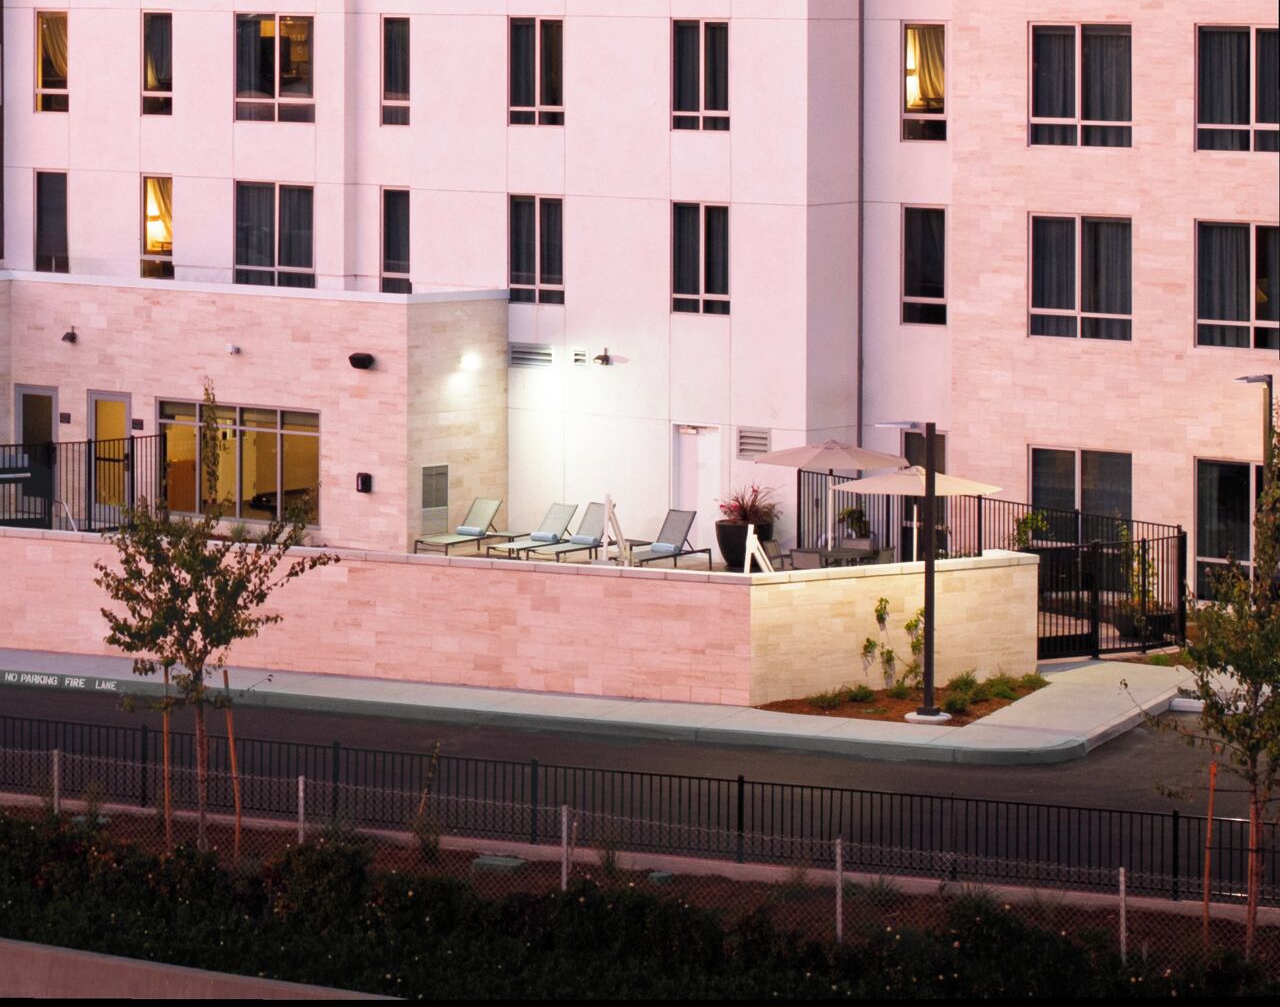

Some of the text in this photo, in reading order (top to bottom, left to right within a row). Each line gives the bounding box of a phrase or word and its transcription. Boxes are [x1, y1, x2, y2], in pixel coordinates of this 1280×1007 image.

[4, 671, 117, 691] NO PARKING FIRE LANE
